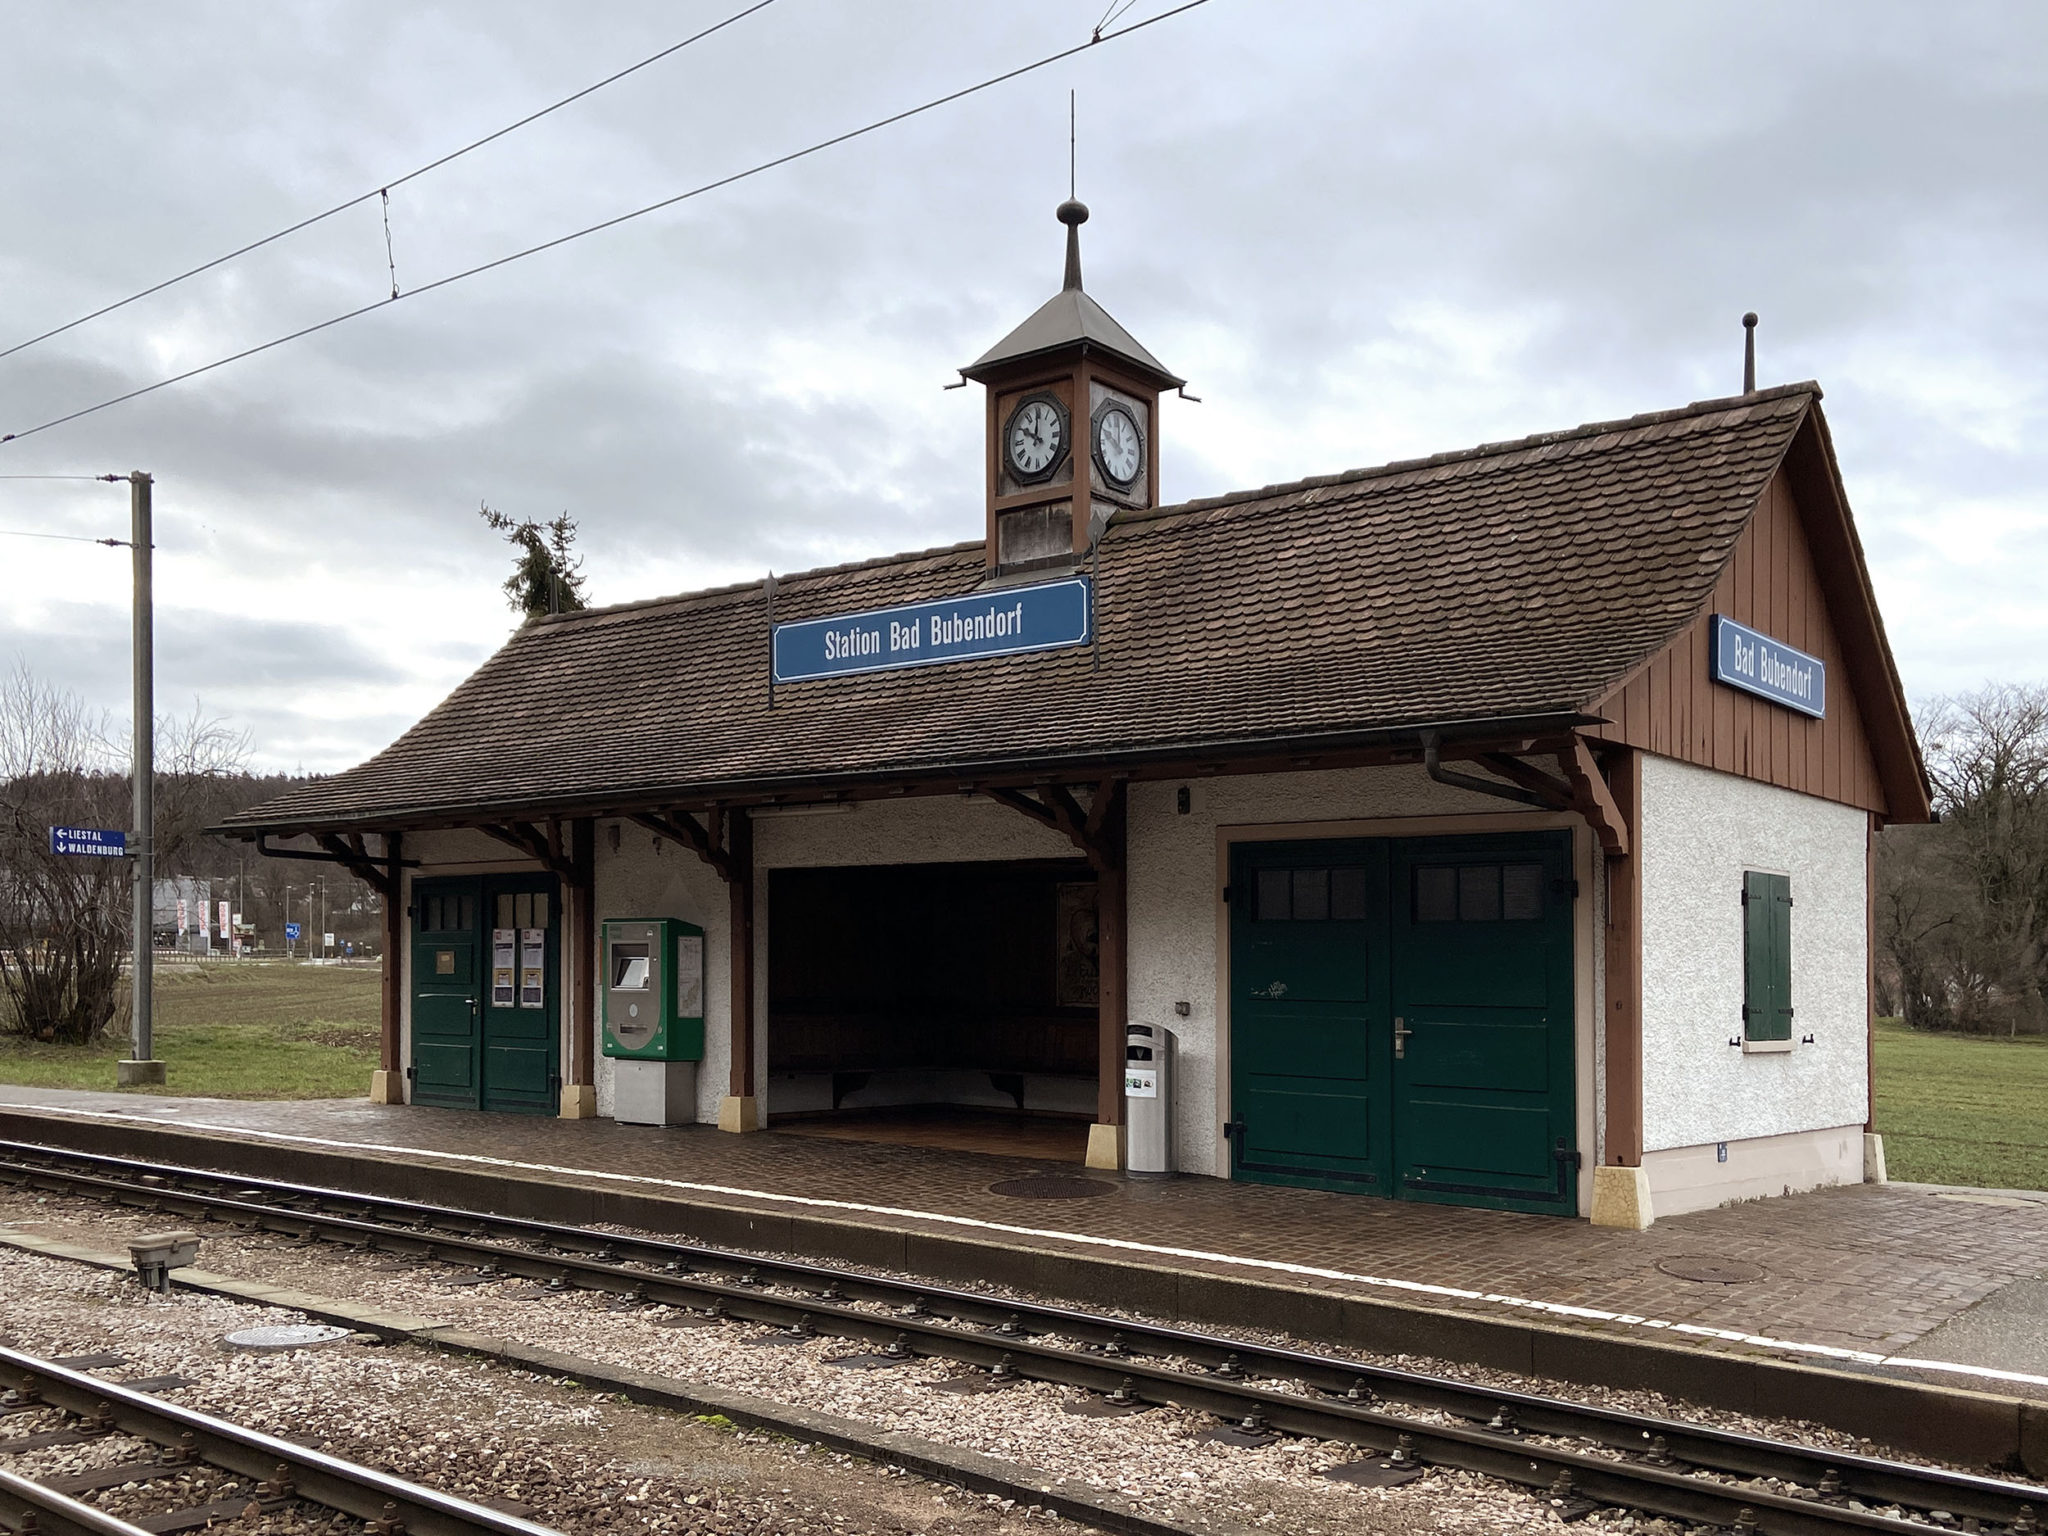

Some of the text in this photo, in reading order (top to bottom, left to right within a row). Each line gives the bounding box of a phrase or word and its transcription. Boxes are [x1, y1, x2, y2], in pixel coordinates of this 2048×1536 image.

[825, 602, 1024, 661] Station Bad Bubendorf
[1735, 634, 1812, 701] Bad Bubendorf
[68, 843, 124, 856] WALDENBURG
[69, 830, 102, 842] LIESTAL
